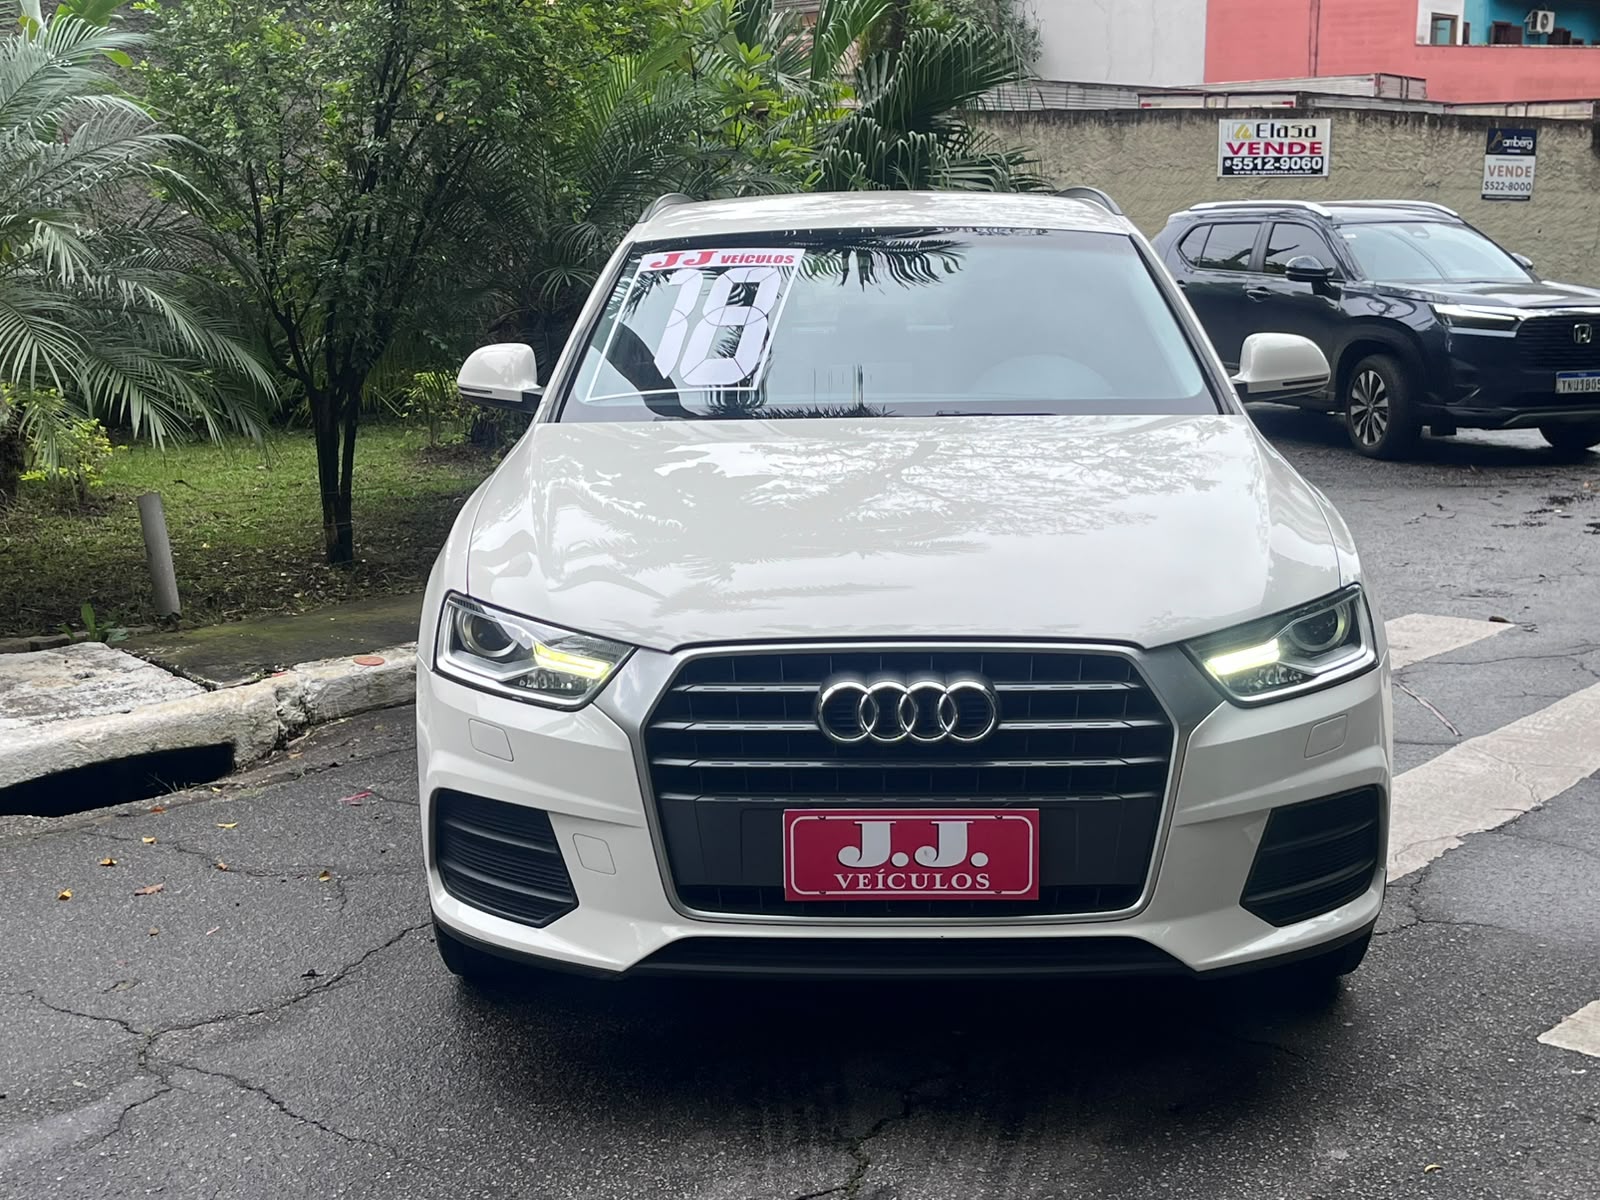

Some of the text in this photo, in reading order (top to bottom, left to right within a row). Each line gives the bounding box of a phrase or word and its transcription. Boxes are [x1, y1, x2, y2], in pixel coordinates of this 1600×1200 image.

[1226, 142, 1322, 155] VENDE
[1232, 157, 1322, 170] 5512-9060
[1488, 165, 1532, 178] VENDE
[1484, 181, 1532, 191] 5522-8000
[720, 254, 795, 264] VEÍCULOS
[653, 267, 781, 386] 18
[837, 820, 989, 867] J.J.
[834, 868, 991, 889] VEÍCULOS
